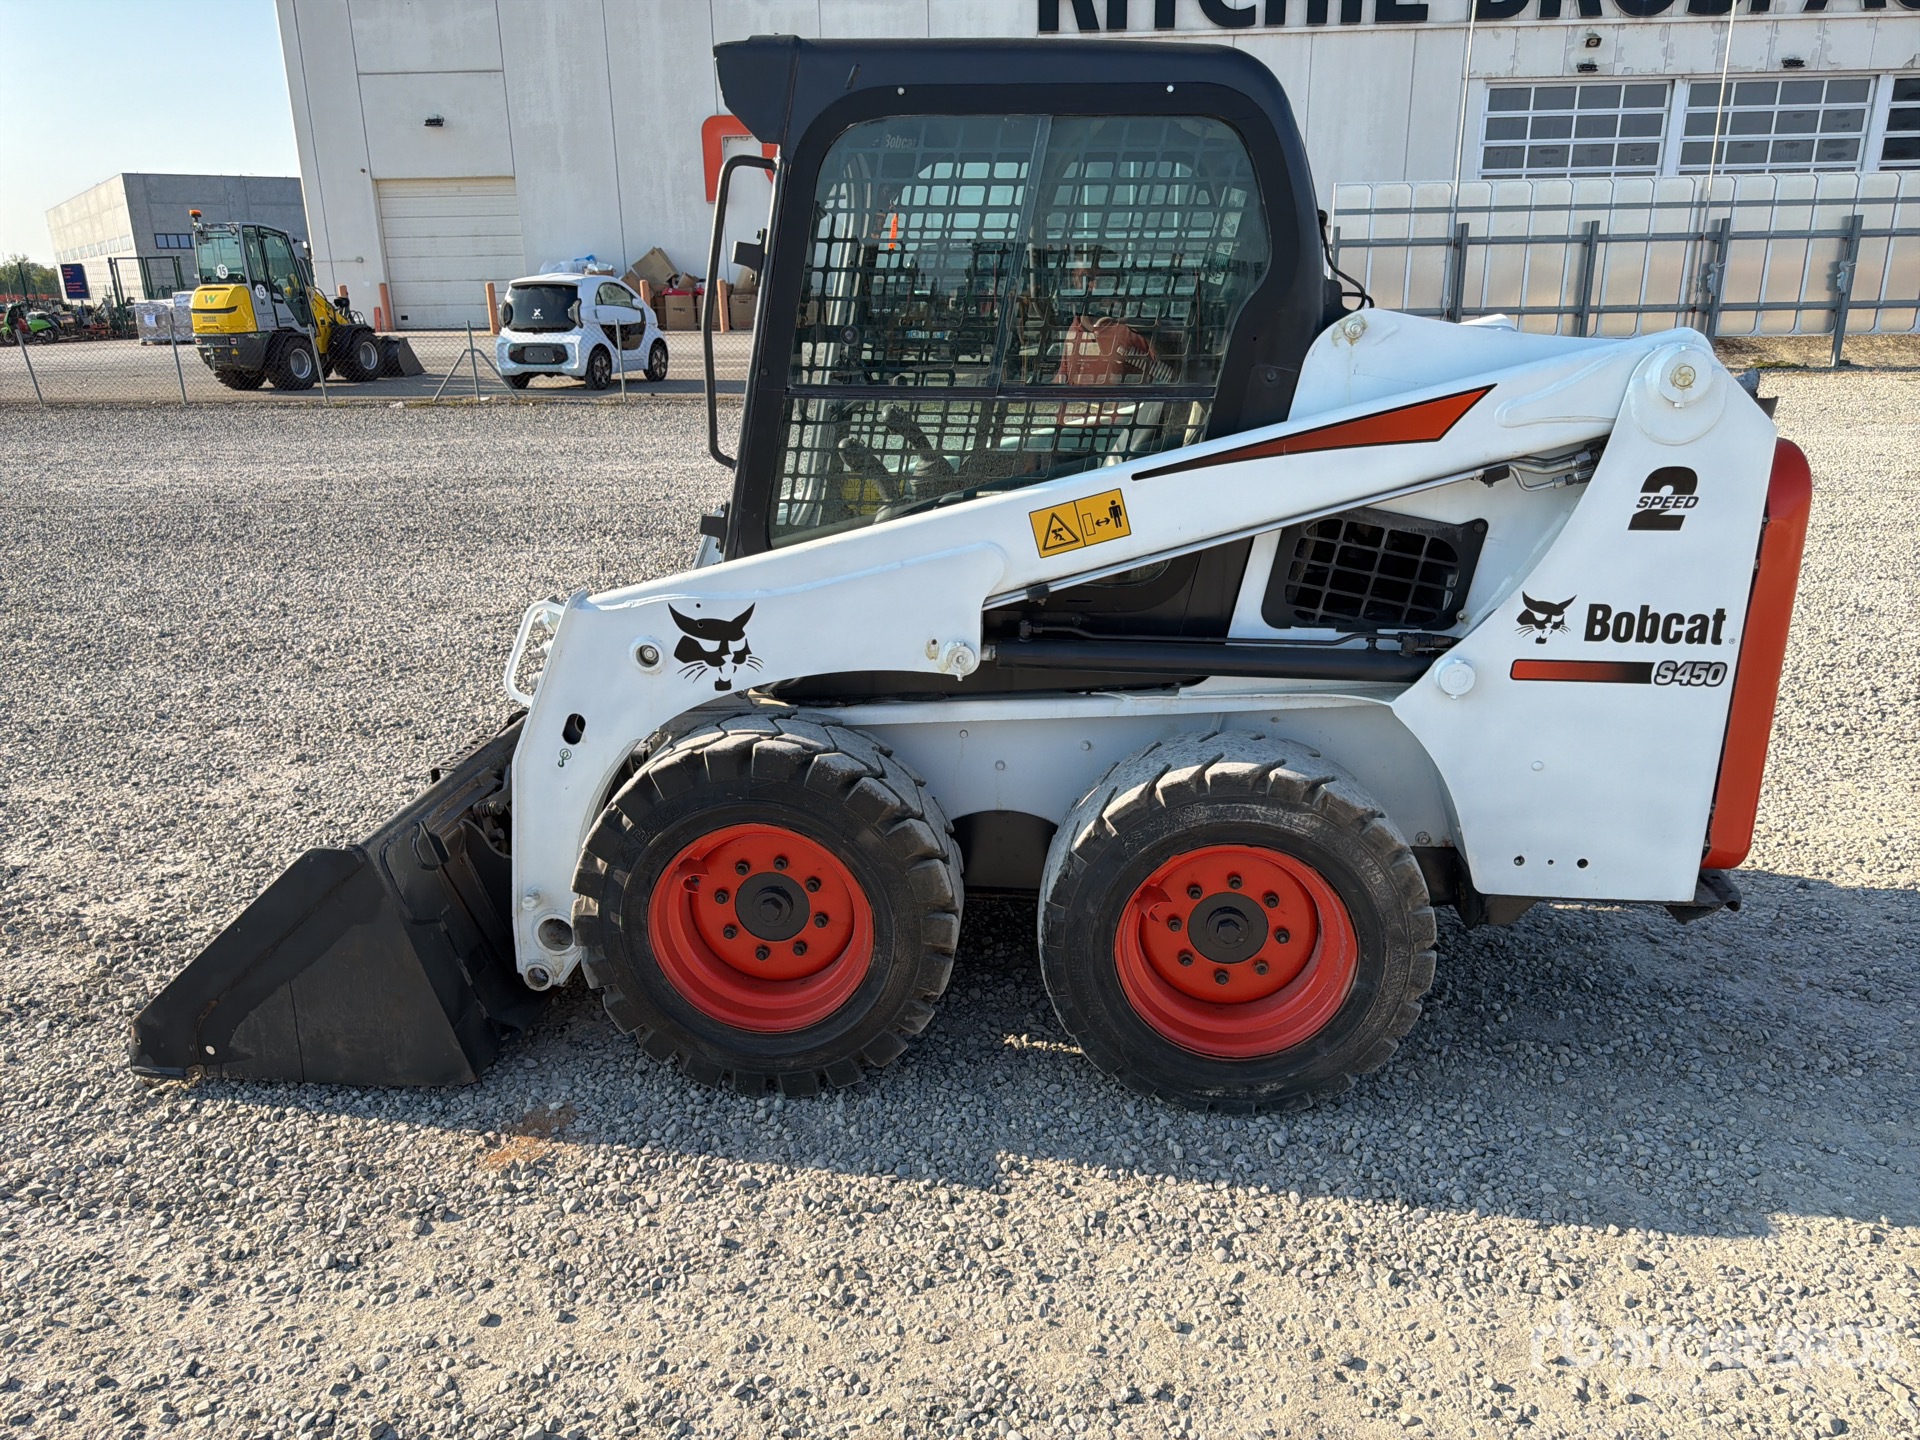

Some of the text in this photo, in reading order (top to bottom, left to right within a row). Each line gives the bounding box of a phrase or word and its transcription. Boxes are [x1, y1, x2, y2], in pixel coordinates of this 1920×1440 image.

[218, 266, 227, 277] 15
[256, 286, 265, 298] 15
[1627, 466, 1698, 531] 2
[1636, 496, 1699, 508] SPEED
[1584, 603, 1726, 645] Bobcat
[1655, 661, 1727, 686] S450
